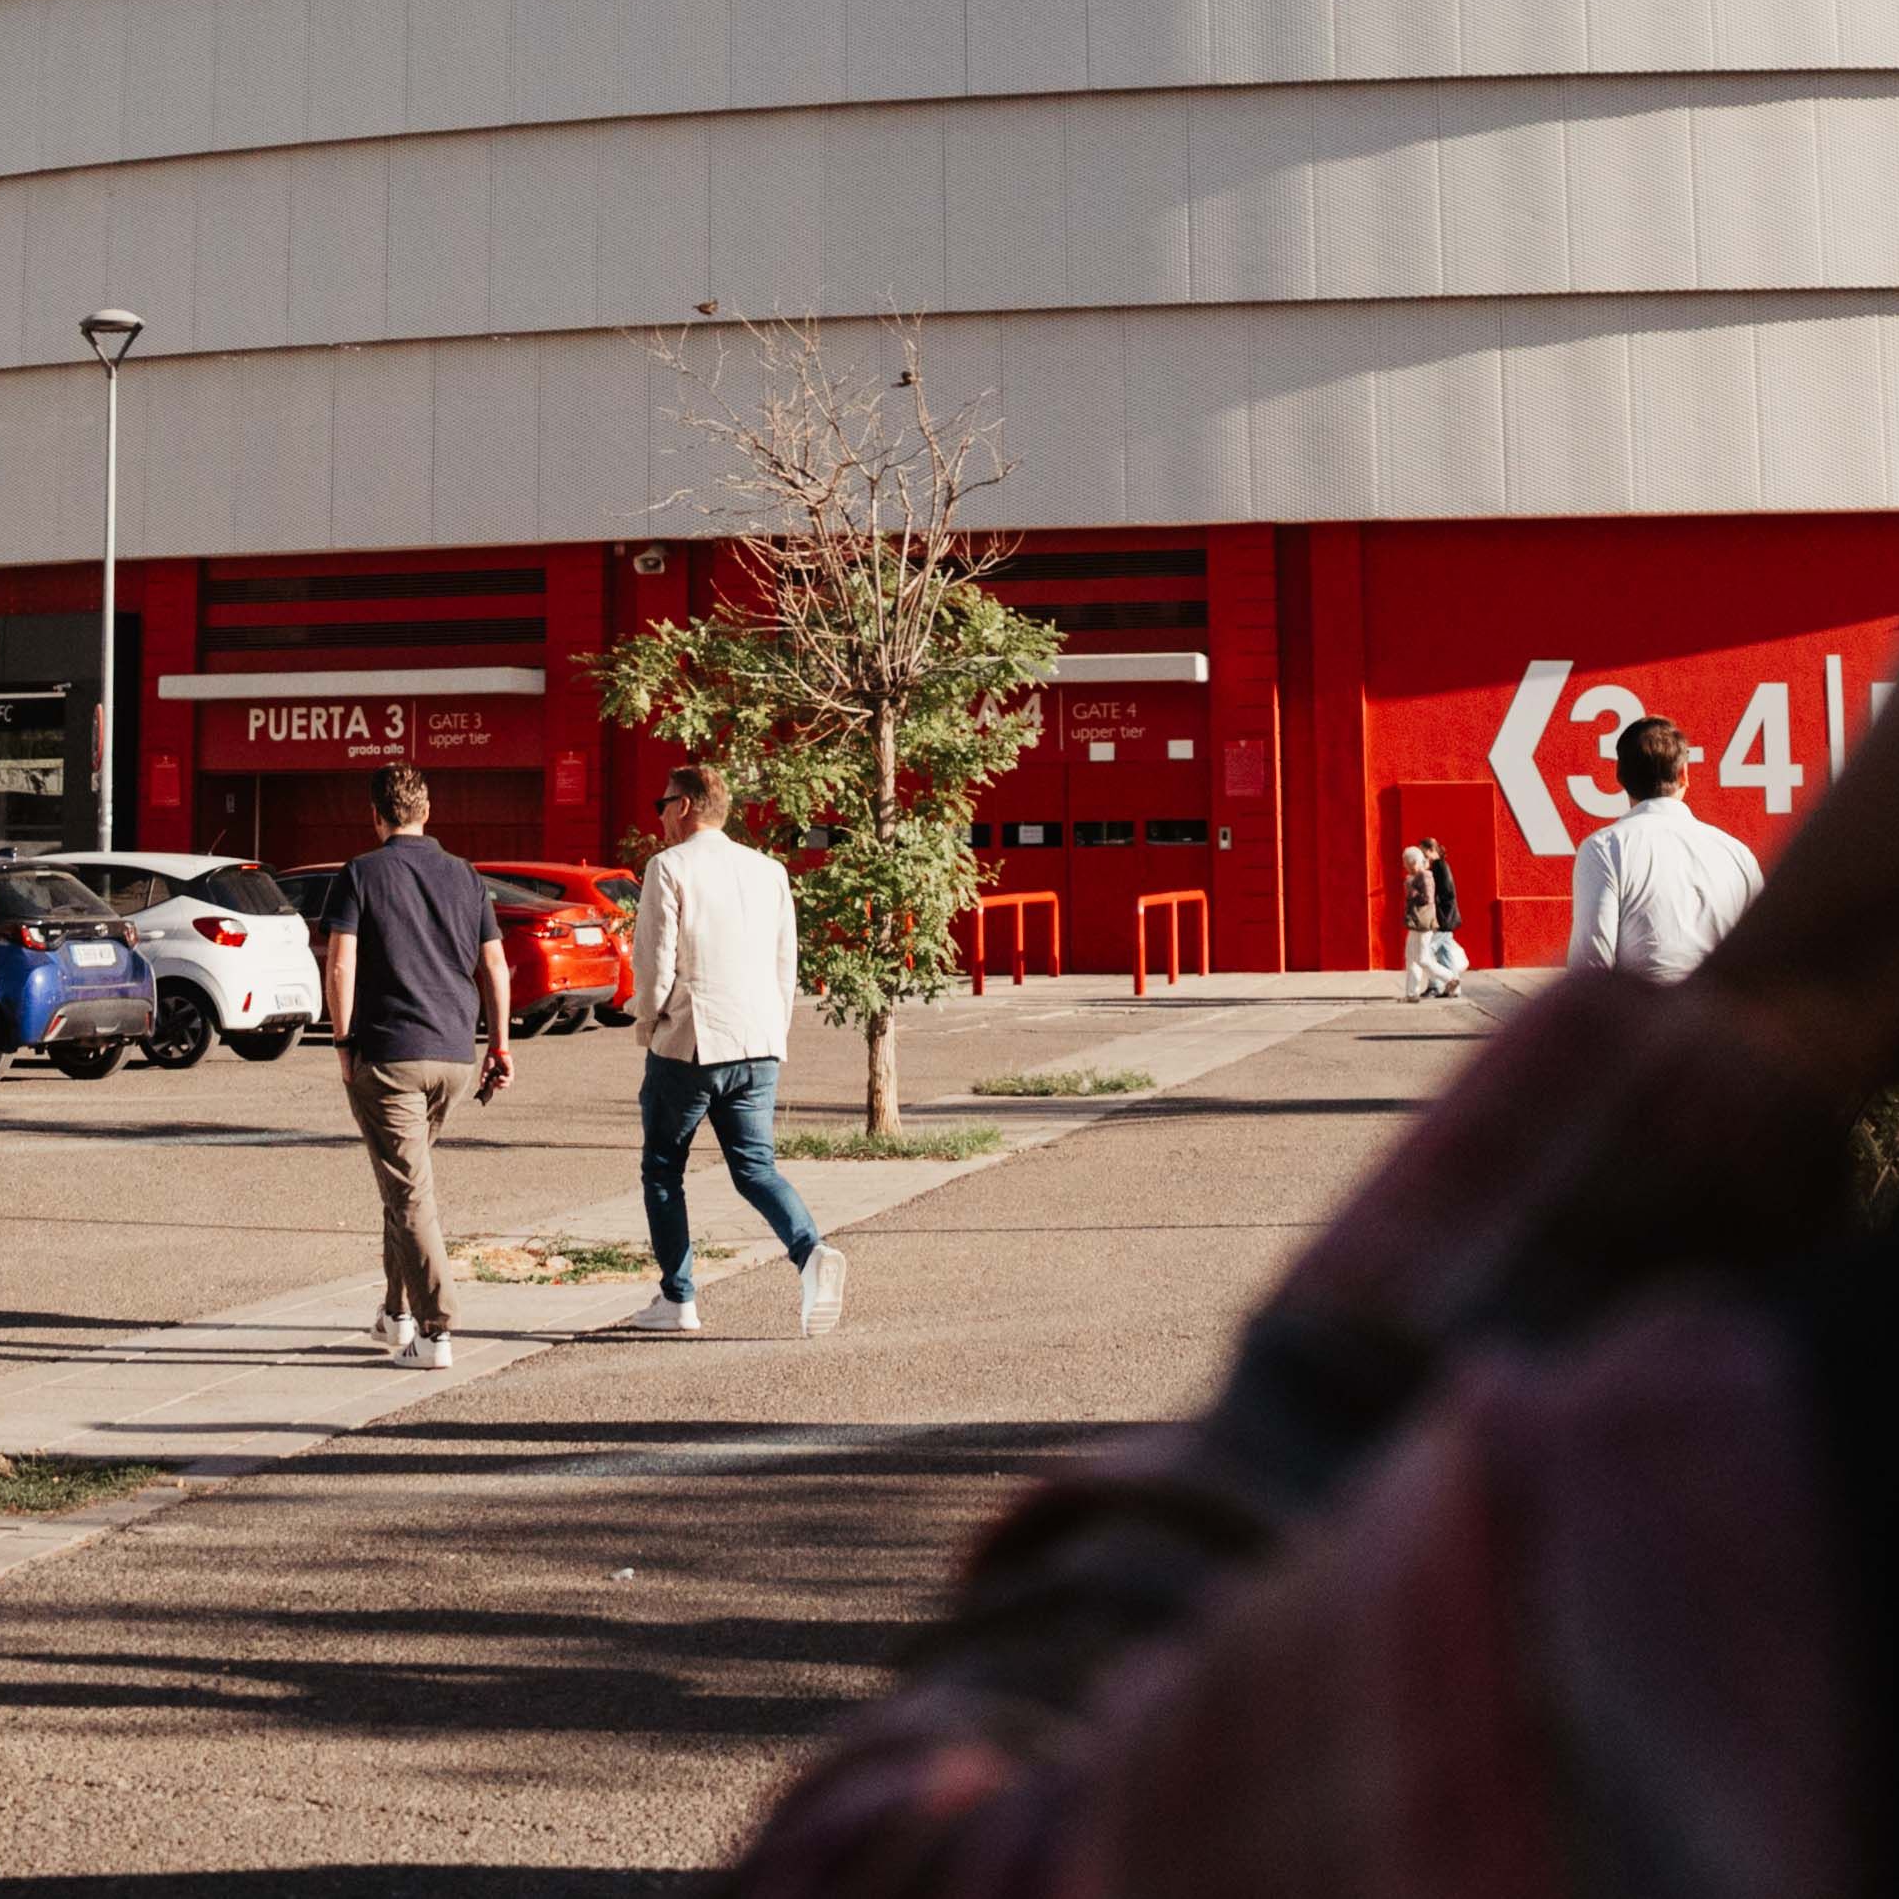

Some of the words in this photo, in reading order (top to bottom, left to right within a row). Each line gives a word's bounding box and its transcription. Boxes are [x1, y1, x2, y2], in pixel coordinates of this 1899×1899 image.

[1072, 702, 1122, 720] GATE
[1126, 702, 1138, 717] 4
[248, 705, 371, 742] PUERTA
[384, 704, 405, 739] 3
[428, 714, 469, 731] GATE
[473, 713, 483, 729] 3
[428, 733, 467, 749] upper
[469, 732, 492, 745] tier
[1071, 728, 1116, 743] upper
[1121, 726, 1146, 739] tier
